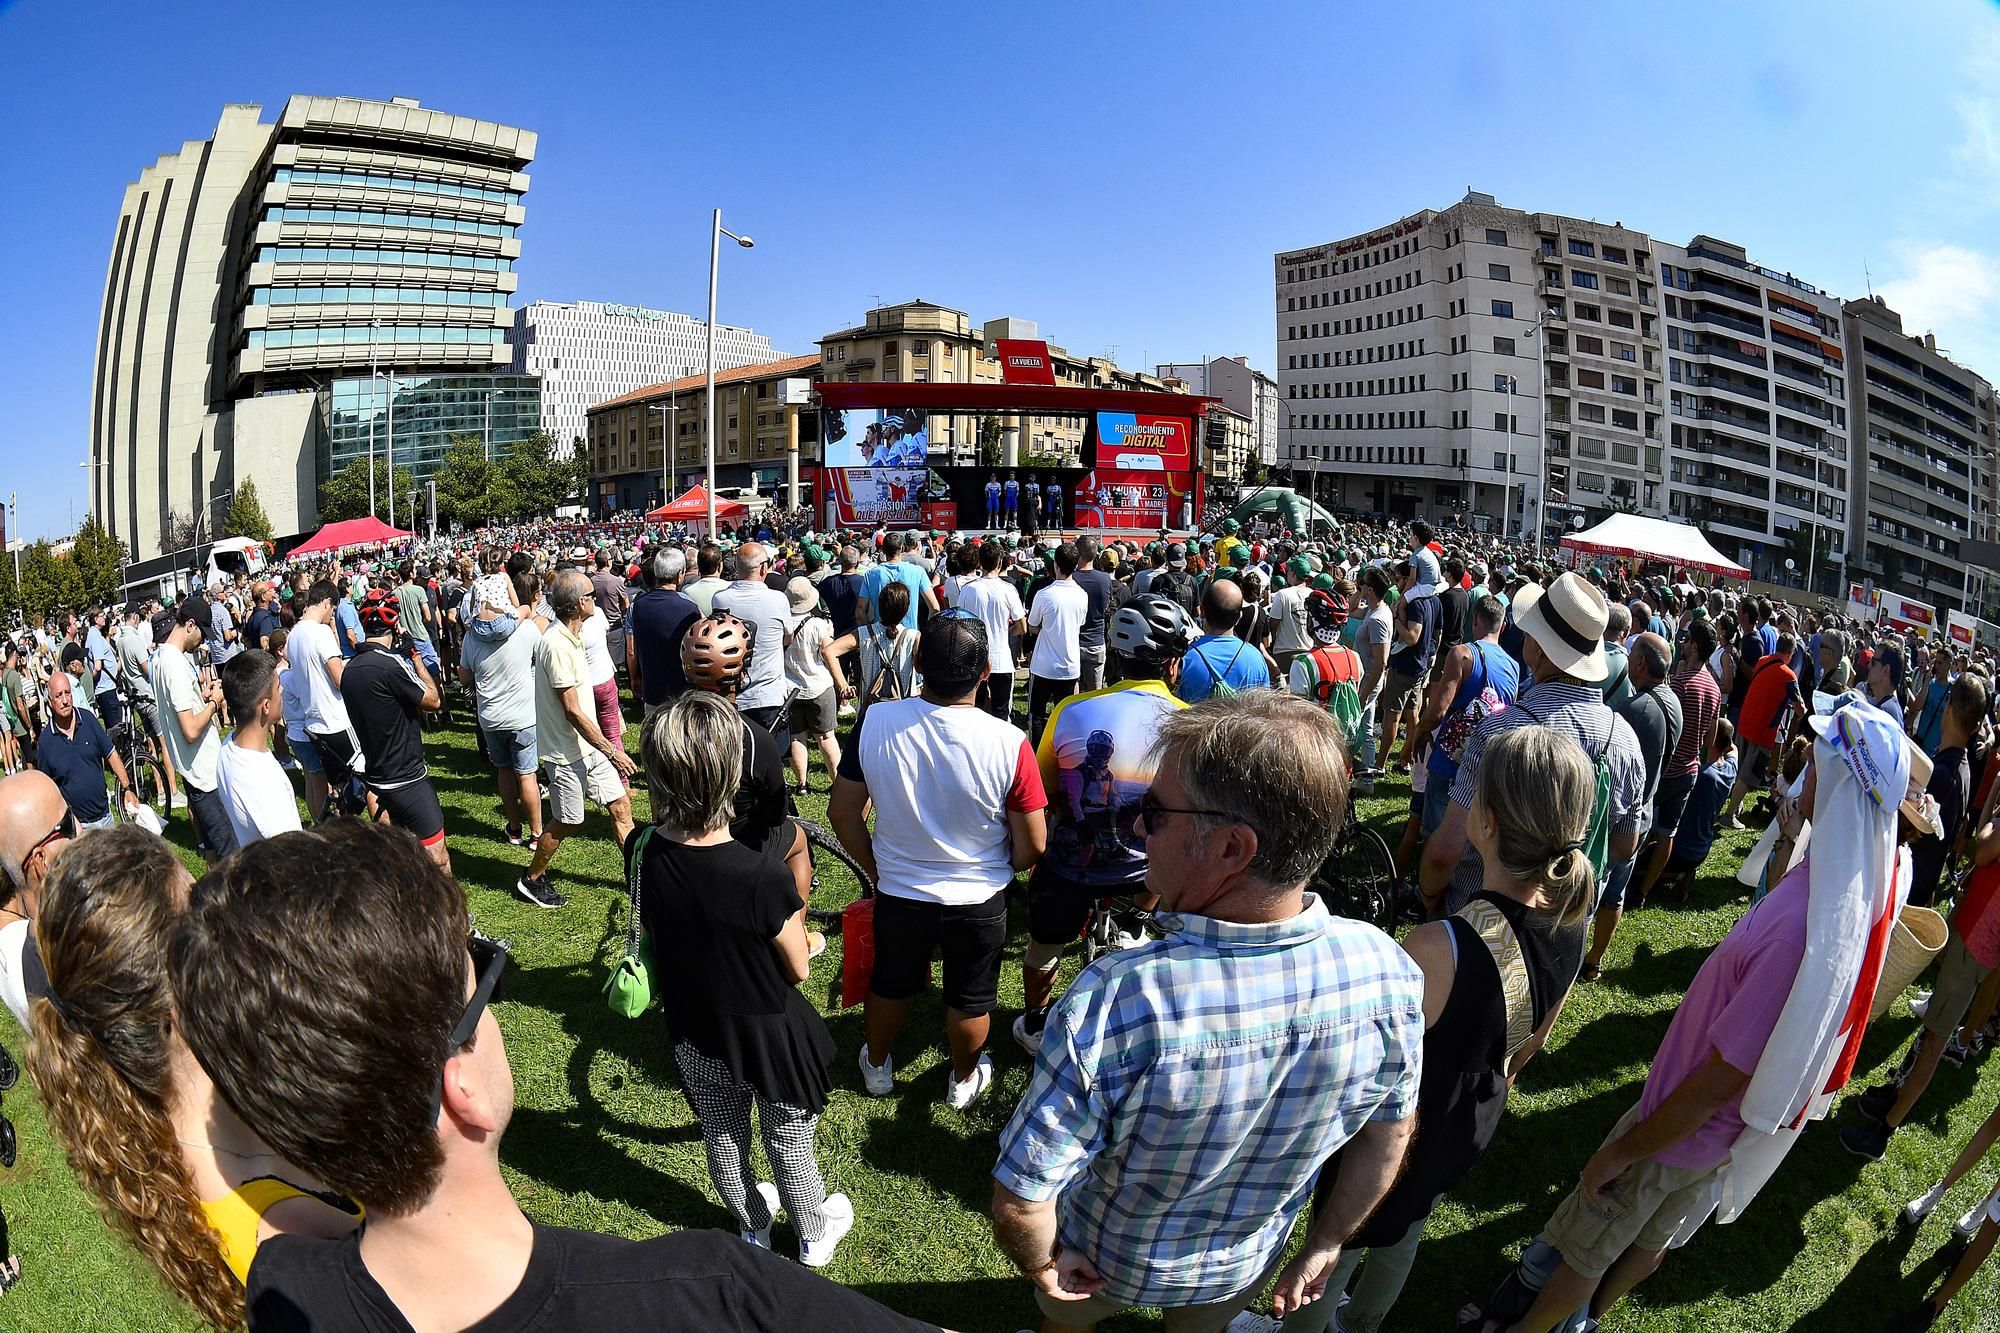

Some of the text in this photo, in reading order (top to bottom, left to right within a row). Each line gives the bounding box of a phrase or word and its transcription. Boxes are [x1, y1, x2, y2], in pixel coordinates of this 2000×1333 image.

[1020, 358, 1041, 366] VUELTA
[1115, 424, 1175, 435] RECONOCIMIENTO
[1122, 434, 1167, 449] DIGITAL
[1152, 487, 1163, 498] 23
[877, 499, 906, 511] PASIÓN
[856, 510, 876, 521] QUE
[876, 510, 895, 521] NOS
[1850, 748, 1870, 790] Venezuela
